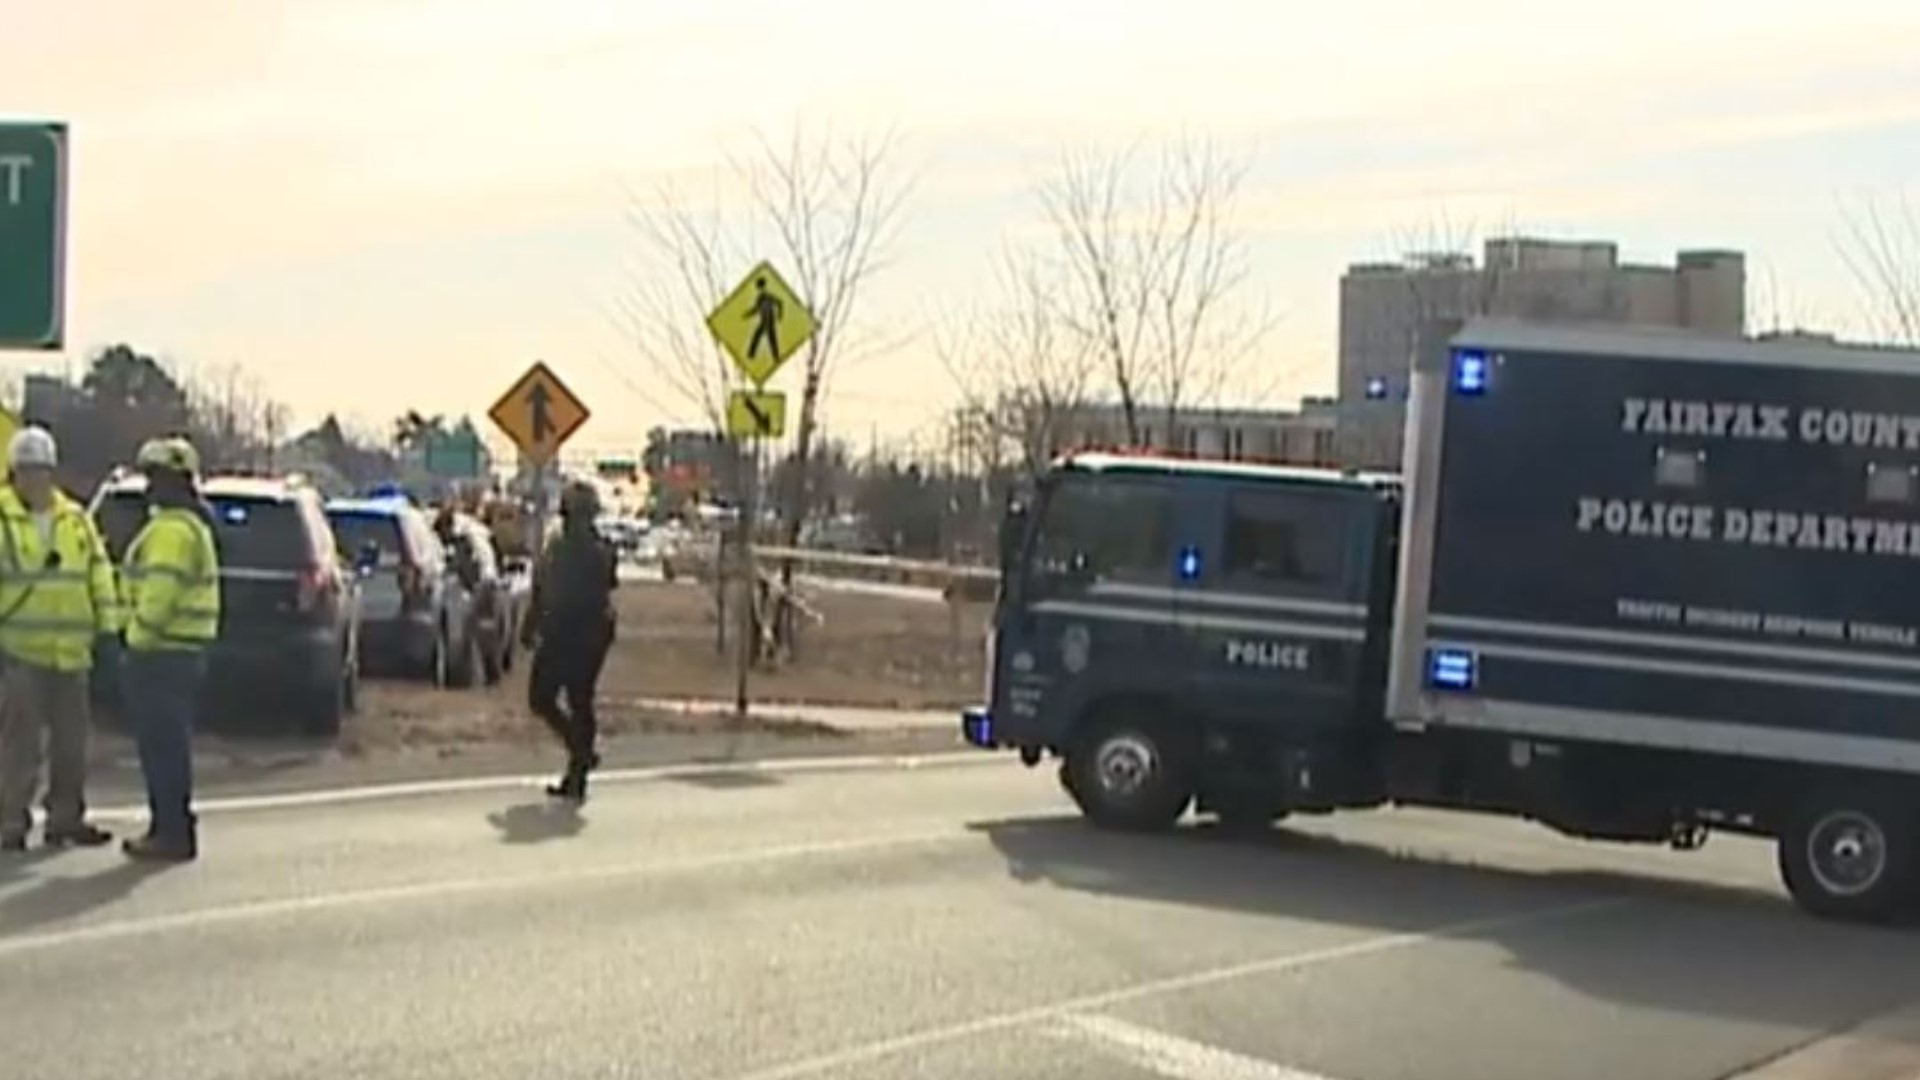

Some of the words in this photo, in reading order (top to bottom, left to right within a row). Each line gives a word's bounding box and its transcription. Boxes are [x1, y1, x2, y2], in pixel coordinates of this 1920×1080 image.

[1621, 397, 1790, 440] FAIRFAX
[1576, 497, 1714, 541] POLICE
[1226, 640, 1309, 670] POLICE
